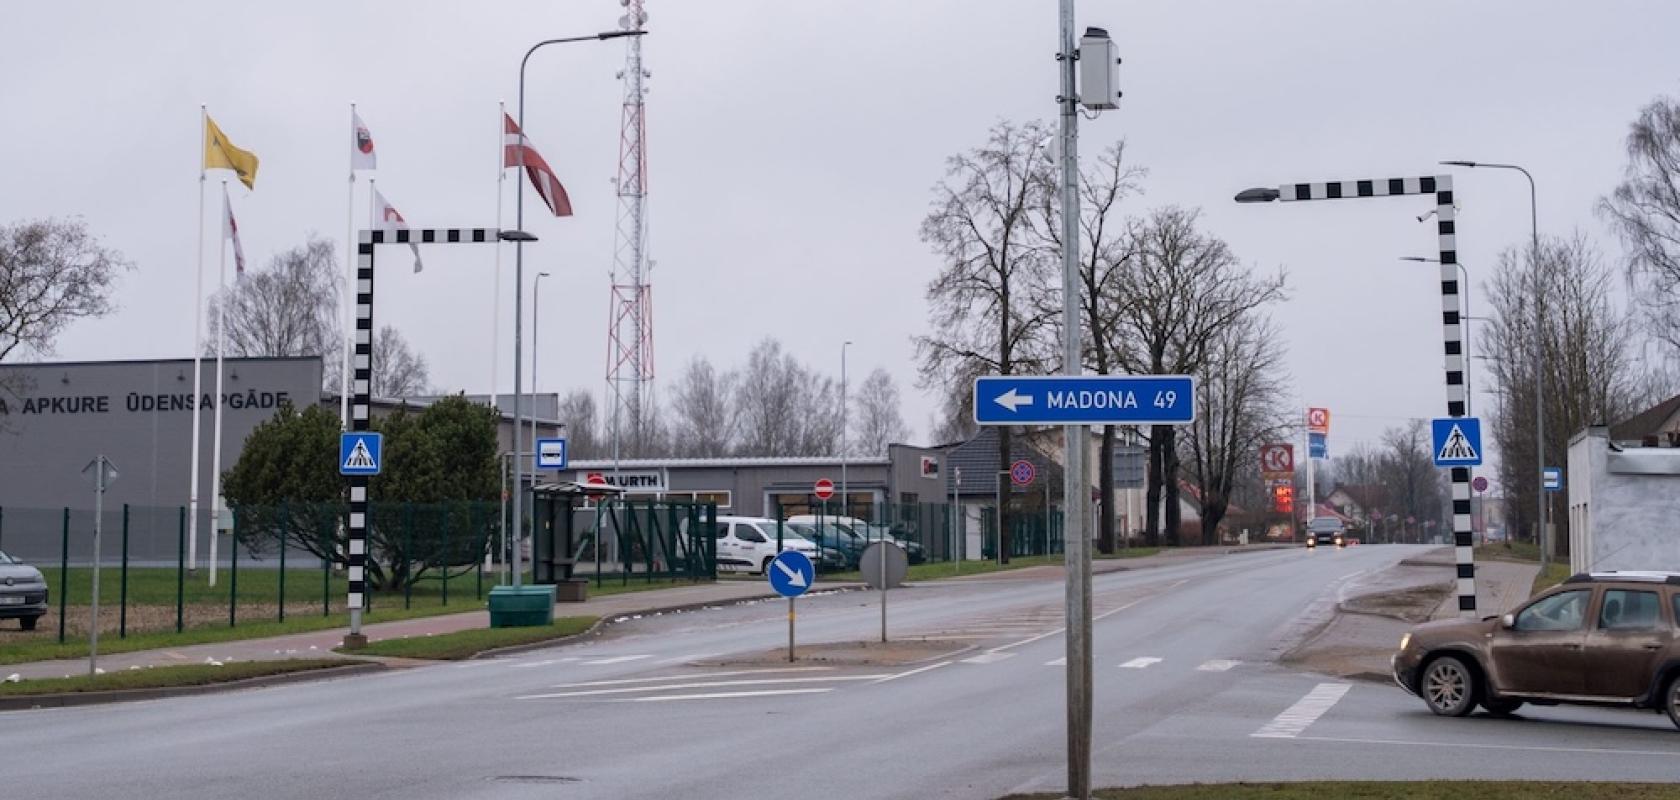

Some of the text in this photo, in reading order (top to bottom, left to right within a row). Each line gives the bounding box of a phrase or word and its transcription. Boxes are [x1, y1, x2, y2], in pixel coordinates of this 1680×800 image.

[22, 396, 109, 414] APKURE
[1048, 390, 1177, 408] MADONA 49
